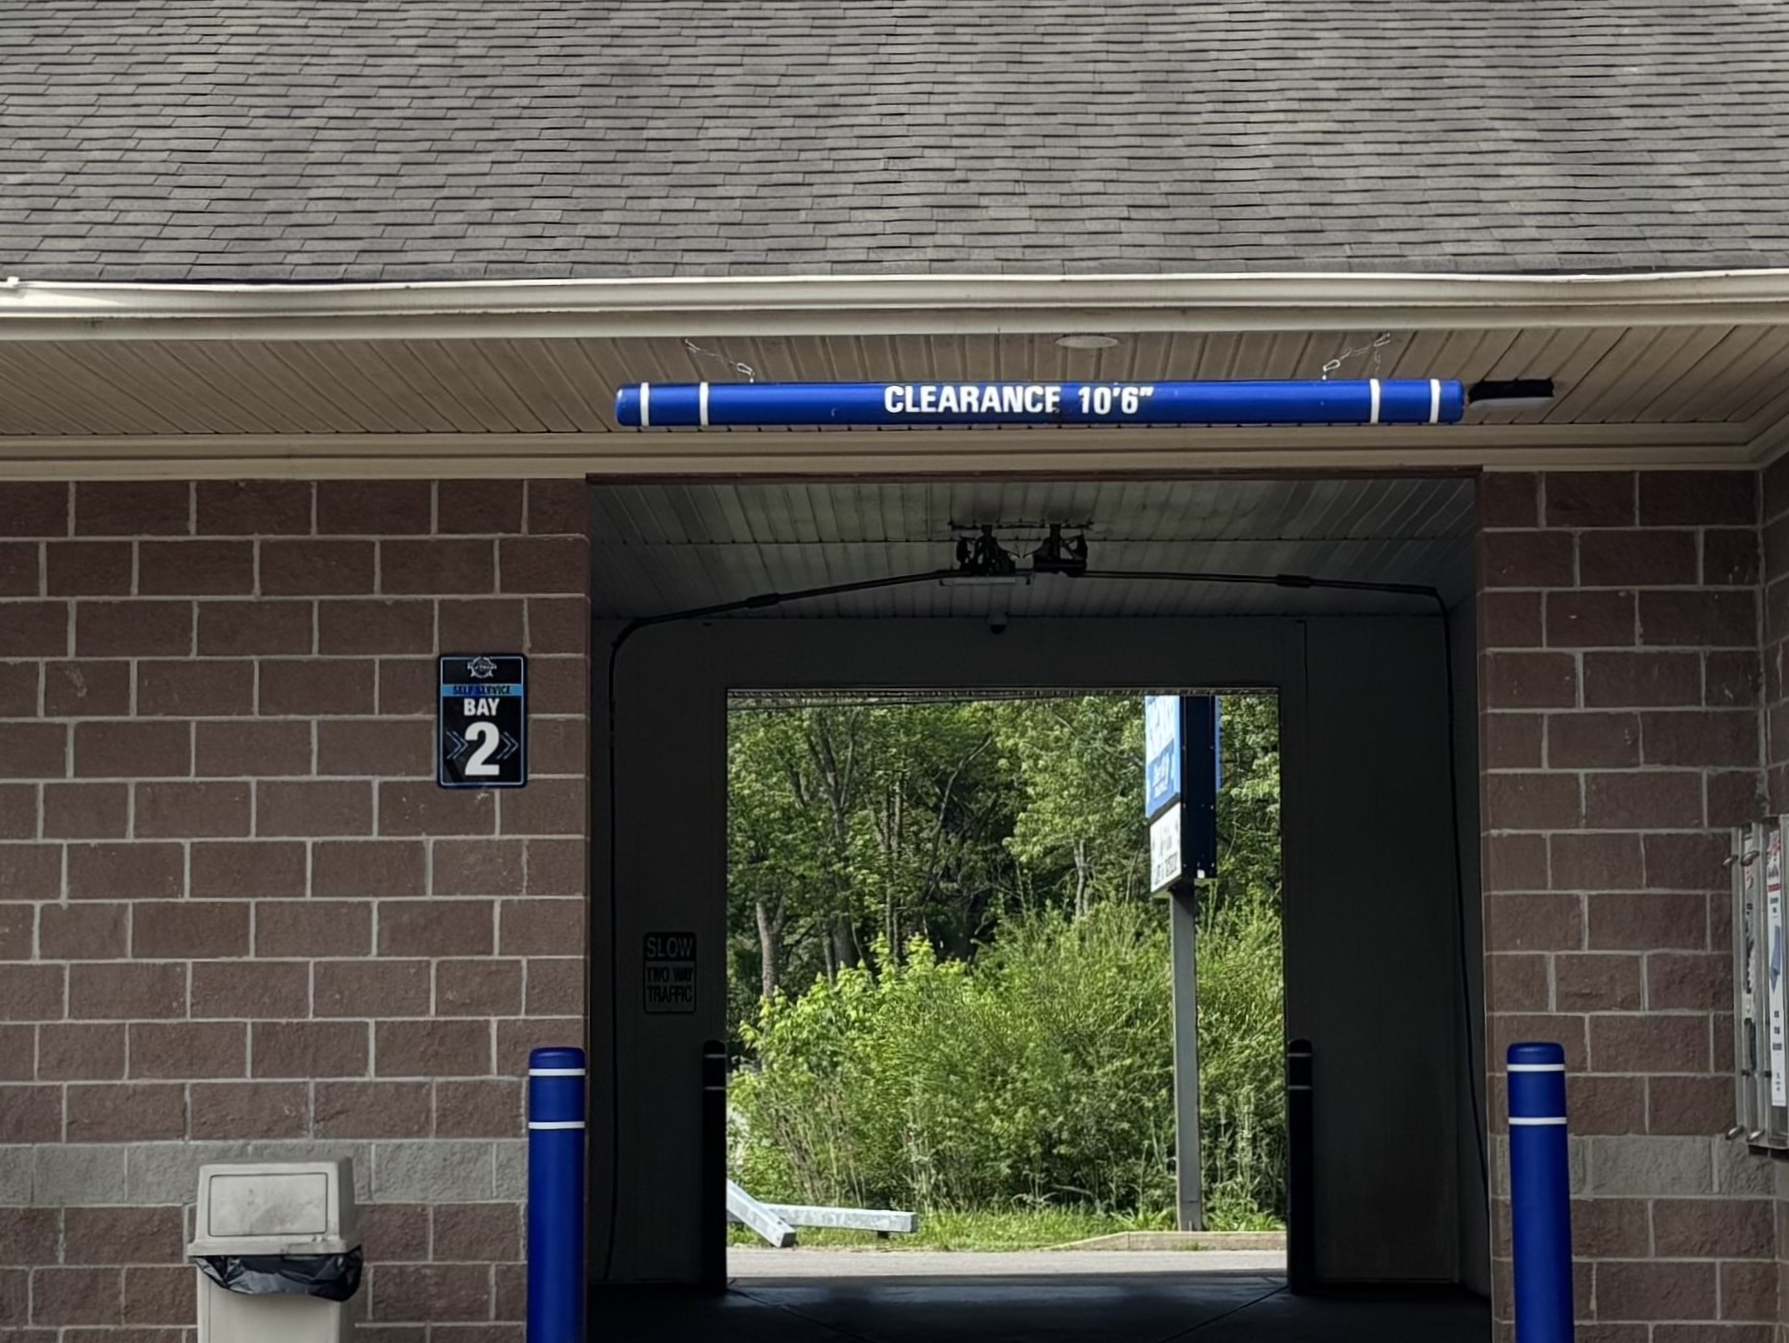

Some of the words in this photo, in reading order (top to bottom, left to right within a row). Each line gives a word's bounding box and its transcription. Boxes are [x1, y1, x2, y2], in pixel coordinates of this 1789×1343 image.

[884, 385, 1061, 413] CLEARANCE
[1078, 385, 1155, 415] 10'6"
[463, 698, 500, 716] BAY
[464, 721, 500, 776] 2
[646, 937, 692, 958] SLOW
[647, 986, 692, 1003] TRAFFIC
